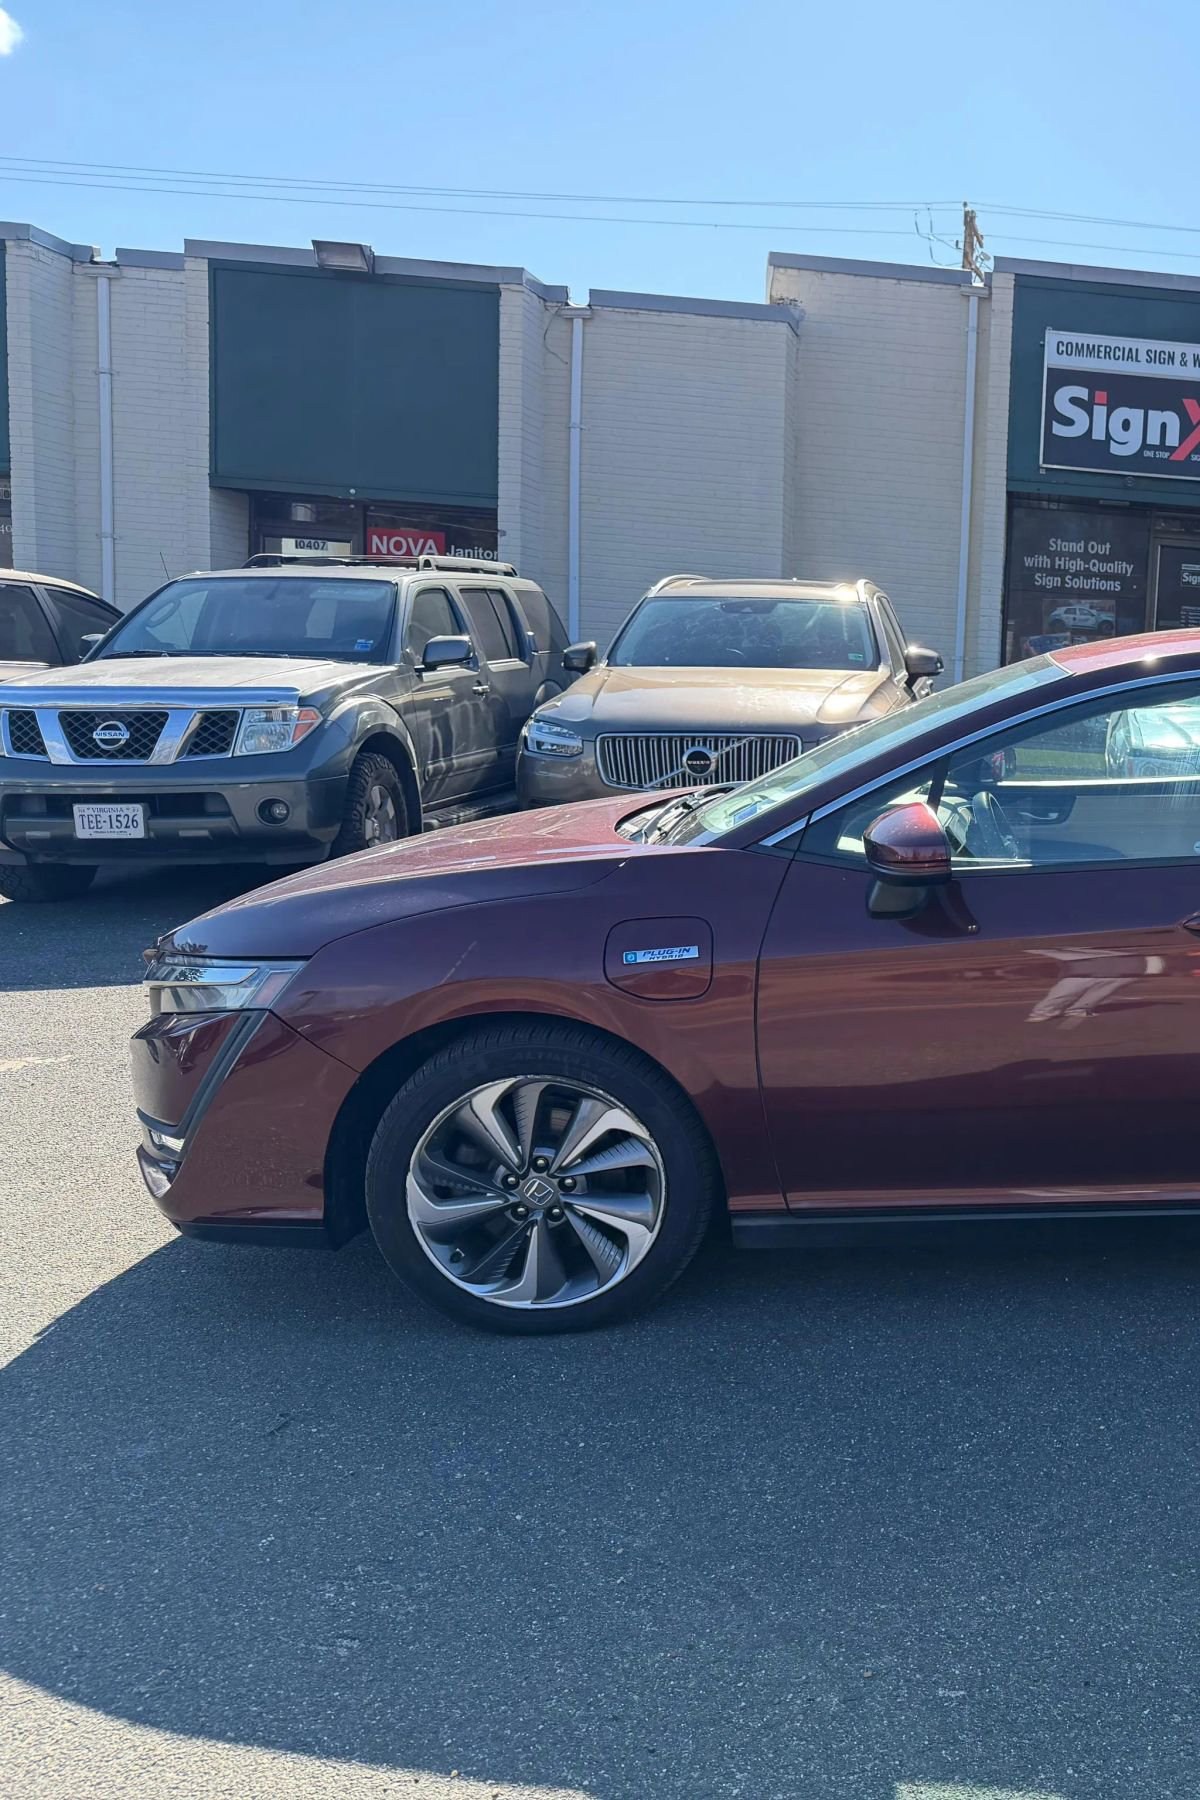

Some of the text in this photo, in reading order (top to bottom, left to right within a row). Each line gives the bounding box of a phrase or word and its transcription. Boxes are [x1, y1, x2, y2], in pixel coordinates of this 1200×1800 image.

[1056, 340, 1141, 363] COMMERCIAL
[1146, 349, 1175, 366] SIGN
[1179, 352, 1188, 367] &
[1143, 450, 1155, 459] ONE
[1156, 451, 1170, 460] STOP
[295, 539, 327, 551] 10407
[370, 534, 439, 556] NOVA
[1049, 538, 1111, 555] Stand Out
[1024, 555, 1134, 577] with High-Quality
[1034, 573, 1121, 592] Sign Solutions
[79, 813, 139, 830] TEE-1526
[642, 947, 691, 957] PLUG-IN
[649, 953, 684, 961] HYBRID
